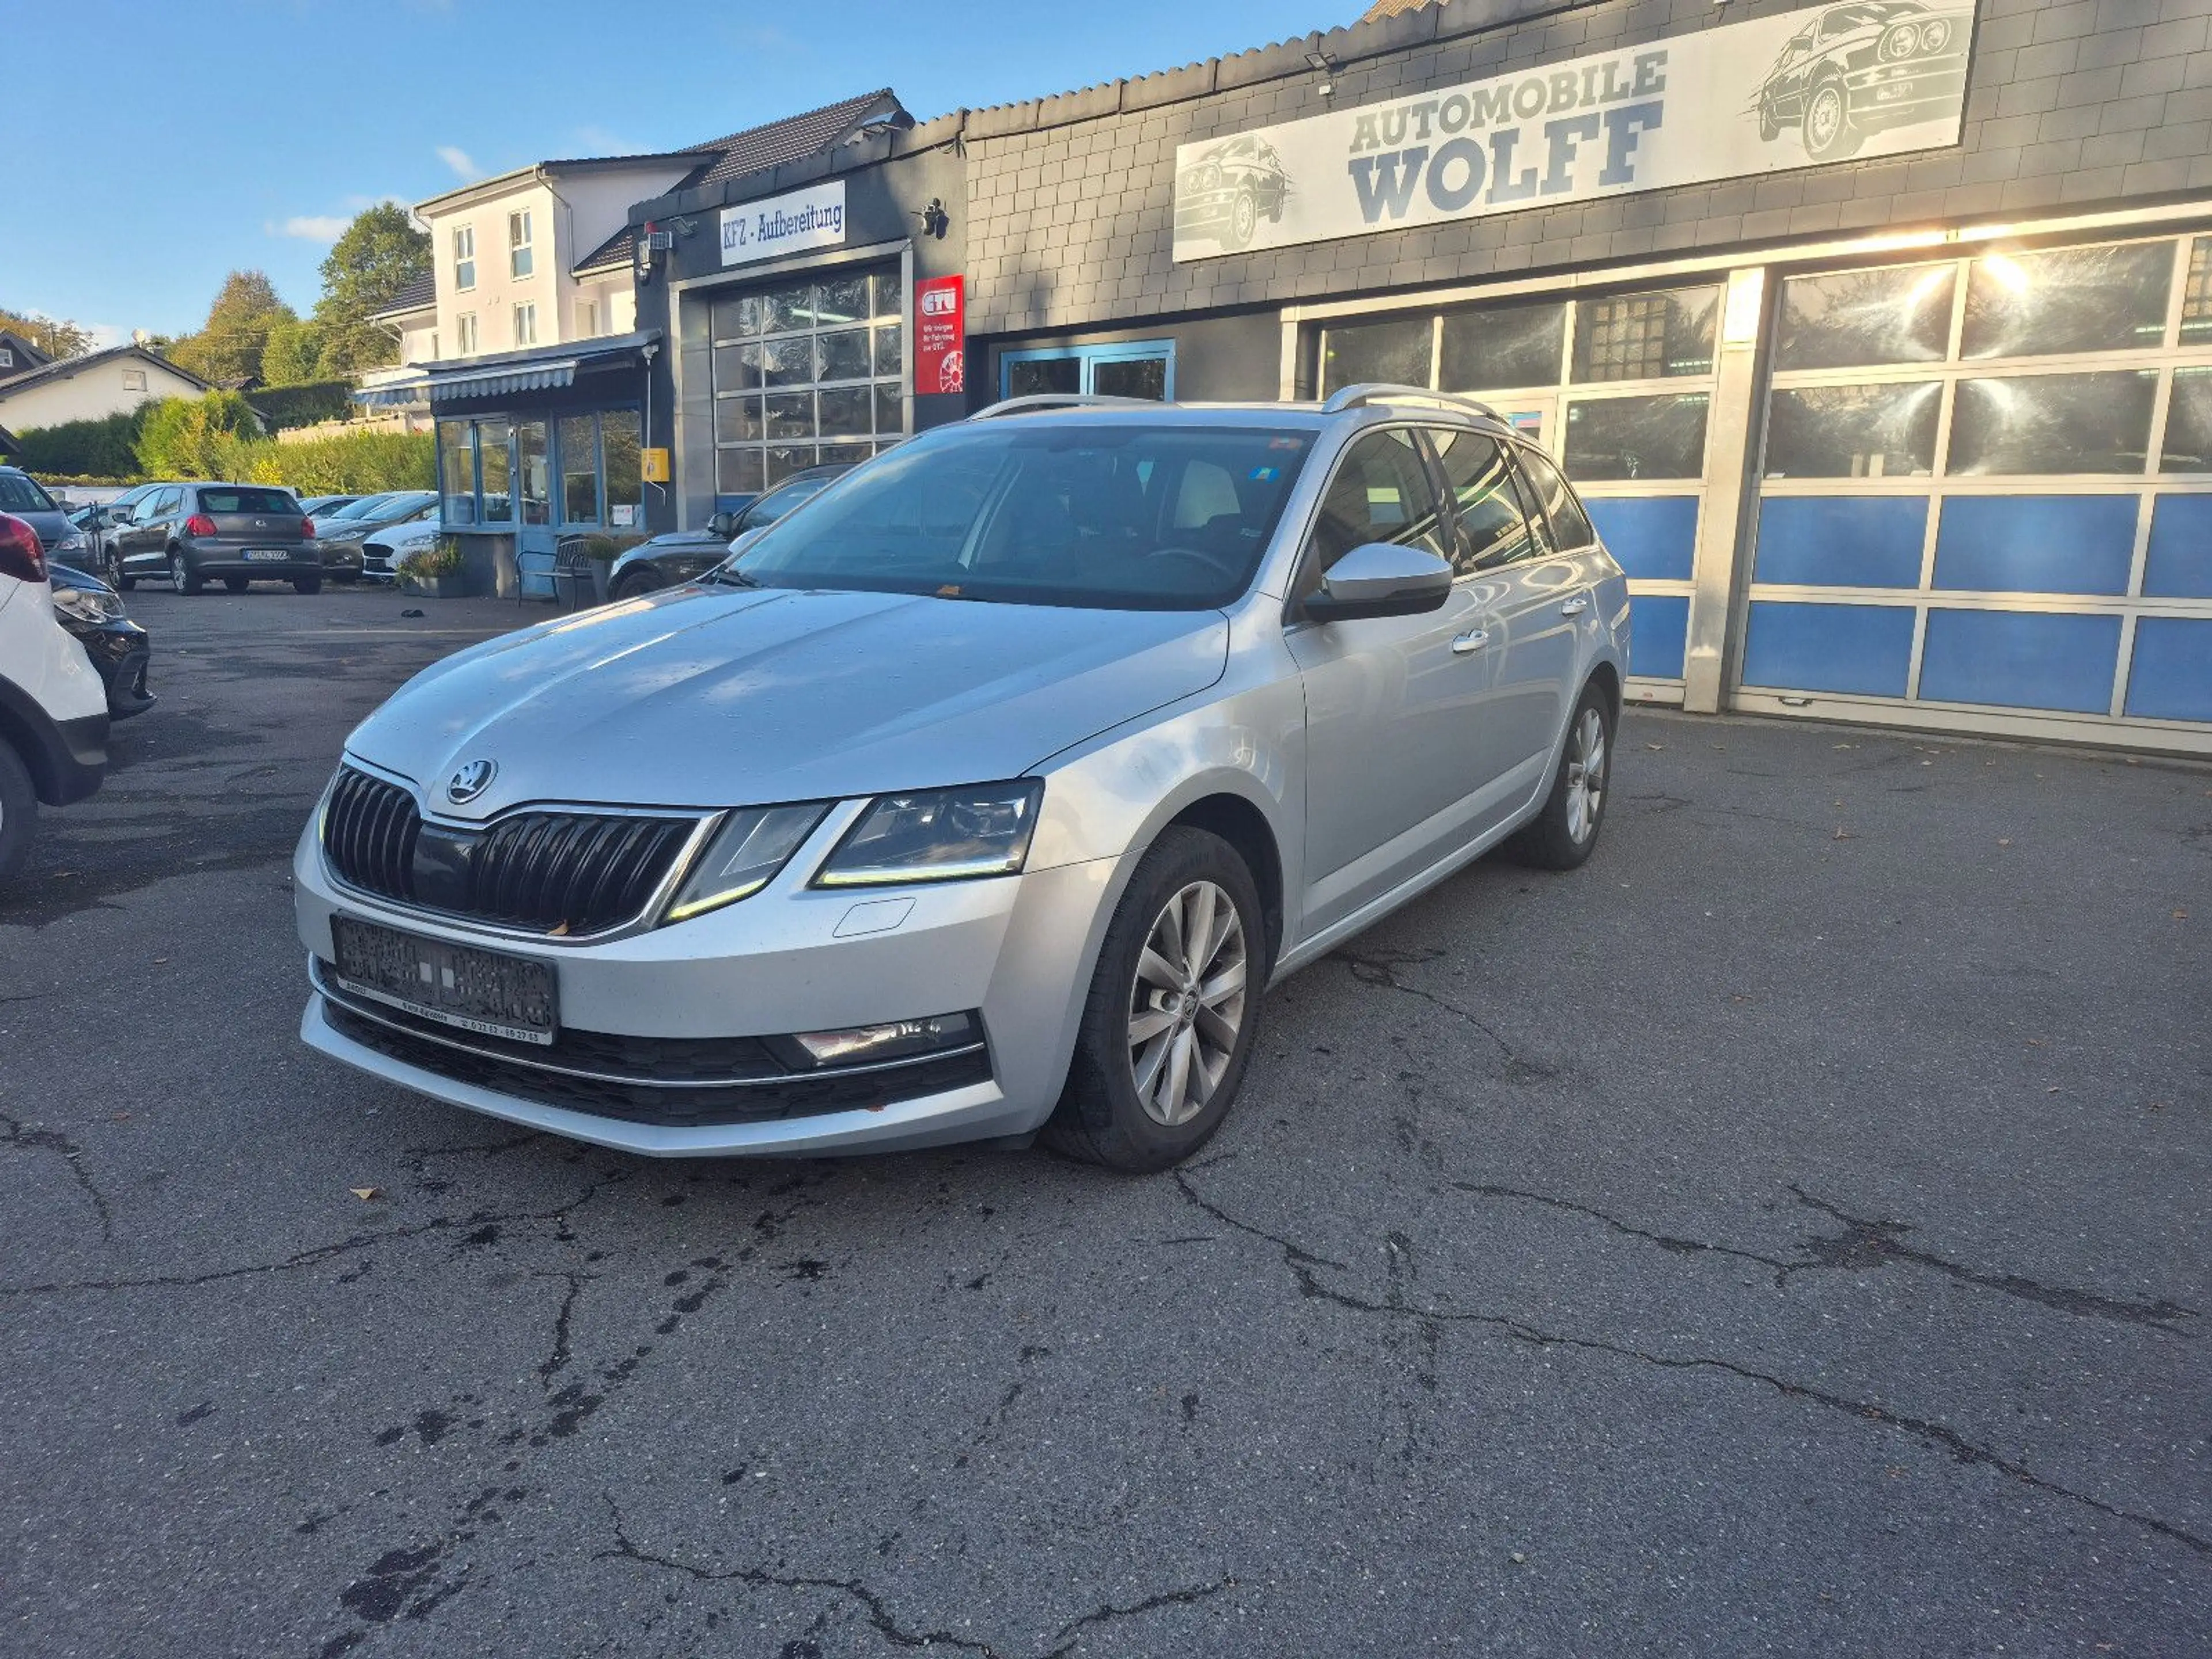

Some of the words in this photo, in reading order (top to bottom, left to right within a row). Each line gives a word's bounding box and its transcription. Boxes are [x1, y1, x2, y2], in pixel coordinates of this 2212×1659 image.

[1349, 49, 1668, 154] AUTOMOBILE
[1348, 100, 1664, 224] WOLFF
[723, 218, 747, 249] KFZ
[757, 204, 842, 241] Aufbereitung
